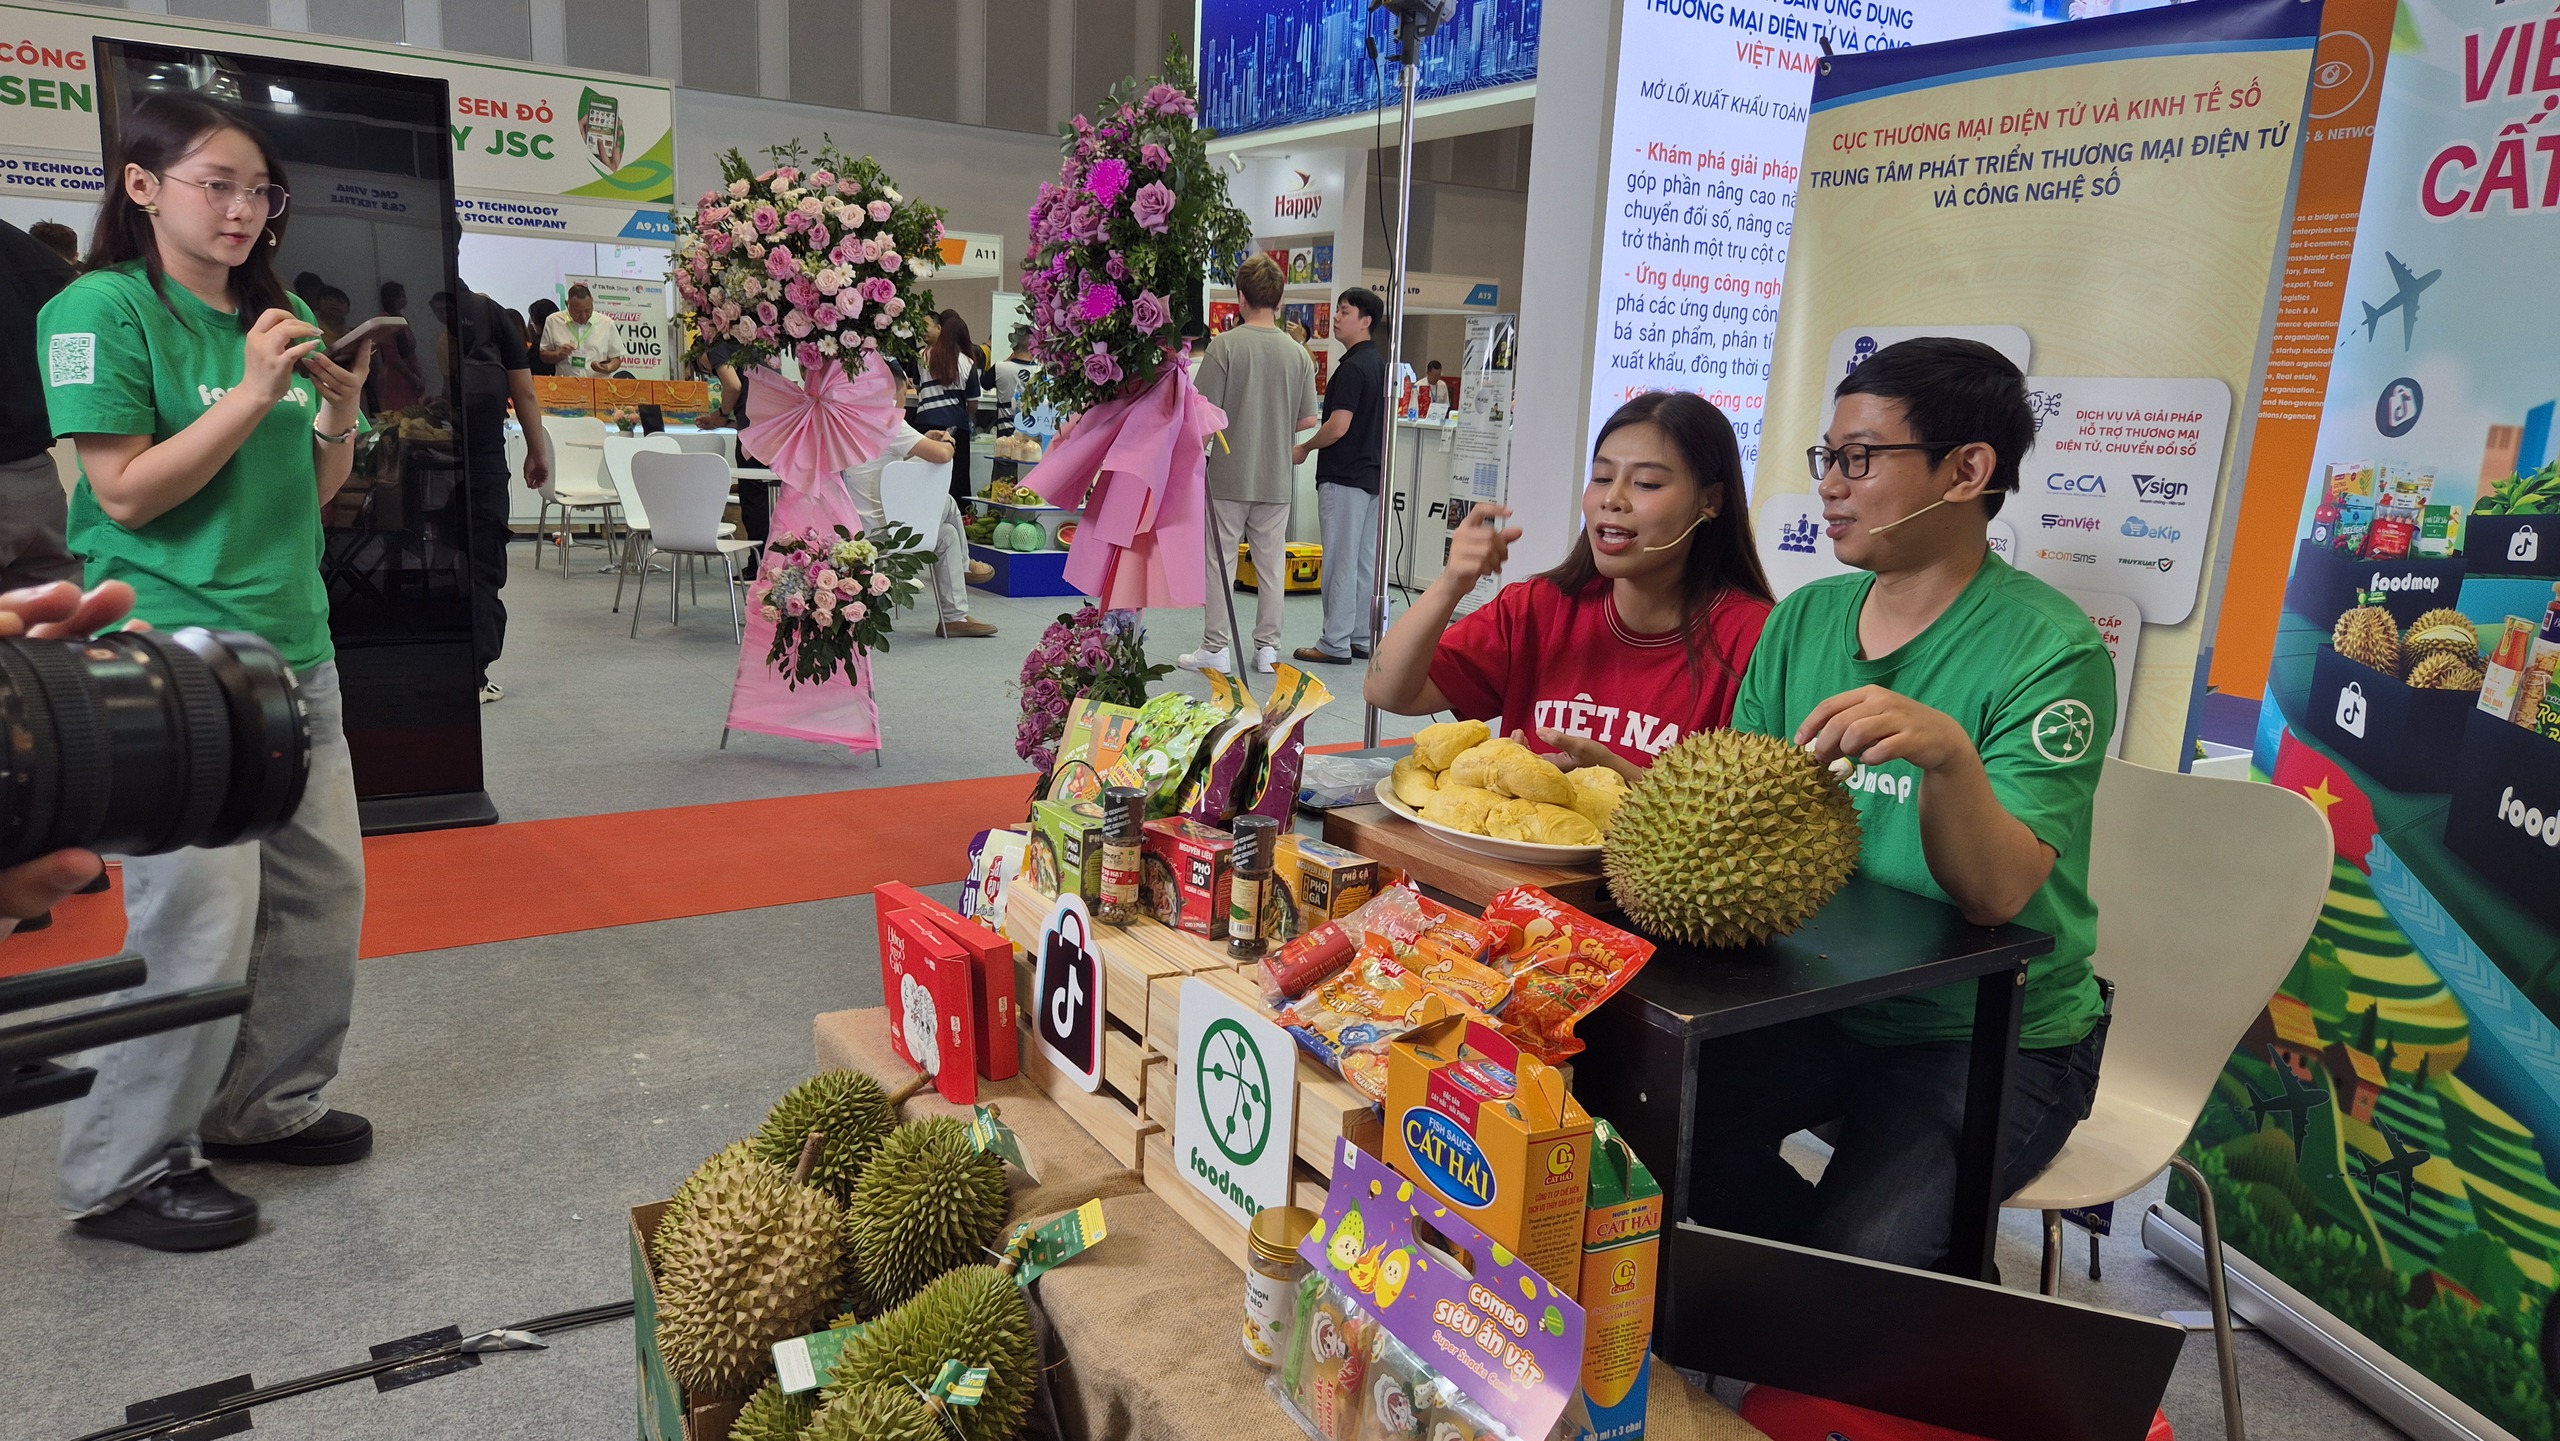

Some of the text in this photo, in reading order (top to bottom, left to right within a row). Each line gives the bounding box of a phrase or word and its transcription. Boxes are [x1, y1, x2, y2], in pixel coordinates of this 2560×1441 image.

[1729, 7, 1763, 36] MẠI
[1767, 13, 1808, 43] ĐIỆN
[1839, 28, 1860, 51] VÀ
[1866, 3, 1914, 30] DỤNG
[0, 40, 87, 71] CÔNG
[1736, 40, 1819, 75] VIỆT NAM
[0, 75, 92, 112] SEN
[1640, 78, 1809, 124] MỞ LỐI XUẤT KHẨU TOÀN
[458, 96, 554, 124] SEN ĐỎ
[1832, 76, 2263, 155] CỤC THƯƠNG MẠI ĐIỆN TỬ VÀ KINH TẾ SỐ
[485, 129, 555, 160] JSC
[1810, 120, 2291, 189] TRUNG TÂM PHÁT TRIỂN THƯƠNG MẠI ĐIỆN TỬ
[22, 161, 104, 177] TECHNOLO
[1647, 142, 1798, 184] Khám phá giải pháp
[6, 175, 105, 191] STOCK COMP
[1627, 170, 1776, 206] góp phần nâng cao
[1934, 166, 2121, 209] VÀ CÔNG NGHỆ SỐ
[478, 201, 559, 217] TECHNOLOGY
[1275, 195, 1322, 219] Happy
[1624, 200, 1773, 239] chuyển đổi số, nâng
[464, 213, 568, 230] STOCK COMPANY
[975, 248, 996, 260] A11
[1622, 228, 1773, 265] trở thành một trụ cột
[1636, 261, 1782, 298] Ứng dụng công ngh
[1616, 293, 1749, 325] phá các ứng dụng
[1613, 321, 1757, 351] bá sản phẩm, phân
[1611, 349, 1758, 379] xuất khẩu, đồng thời
[2076, 409, 2203, 424] DỊCH VỤ VÀ GIẢI PHÁP
[2079, 422, 2200, 442] HỖ TRỢ THƯƠNG MẠI
[2055, 439, 2082, 453] ĐIỆN
[2105, 440, 2154, 455] CHUYỂN
[2156, 442, 2177, 455] ĐỔI
[2180, 441, 2197, 456] SỐ
[2046, 473, 2189, 500] CeCA Vsign
[2148, 526, 2181, 543] eKip
[2370, 571, 2440, 594] foodmap
[2097, 615, 2122, 628] CẤP
[1178, 842, 1213, 860] NGUYÊN LIỆU
[1191, 873, 1205, 887] BÒ
[1193, 860, 1211, 875] PHỞ
[1341, 868, 1357, 882] PHỞ
[1309, 892, 1321, 906] GÀ
[1310, 880, 1328, 894] PHỞ
[1406, 1119, 1448, 1167] CÁT
[1428, 1116, 1473, 1156] FISH SAUCE
[1612, 1205, 1648, 1218] NƯỚC MẮM
[1596, 1219, 1629, 1237] CÁT
[1252, 1288, 1269, 1301] NON
[1432, 1329, 1459, 1356] Super
[1457, 1348, 1489, 1380] Snacks
[1625, 1420, 1642, 1434] chai
